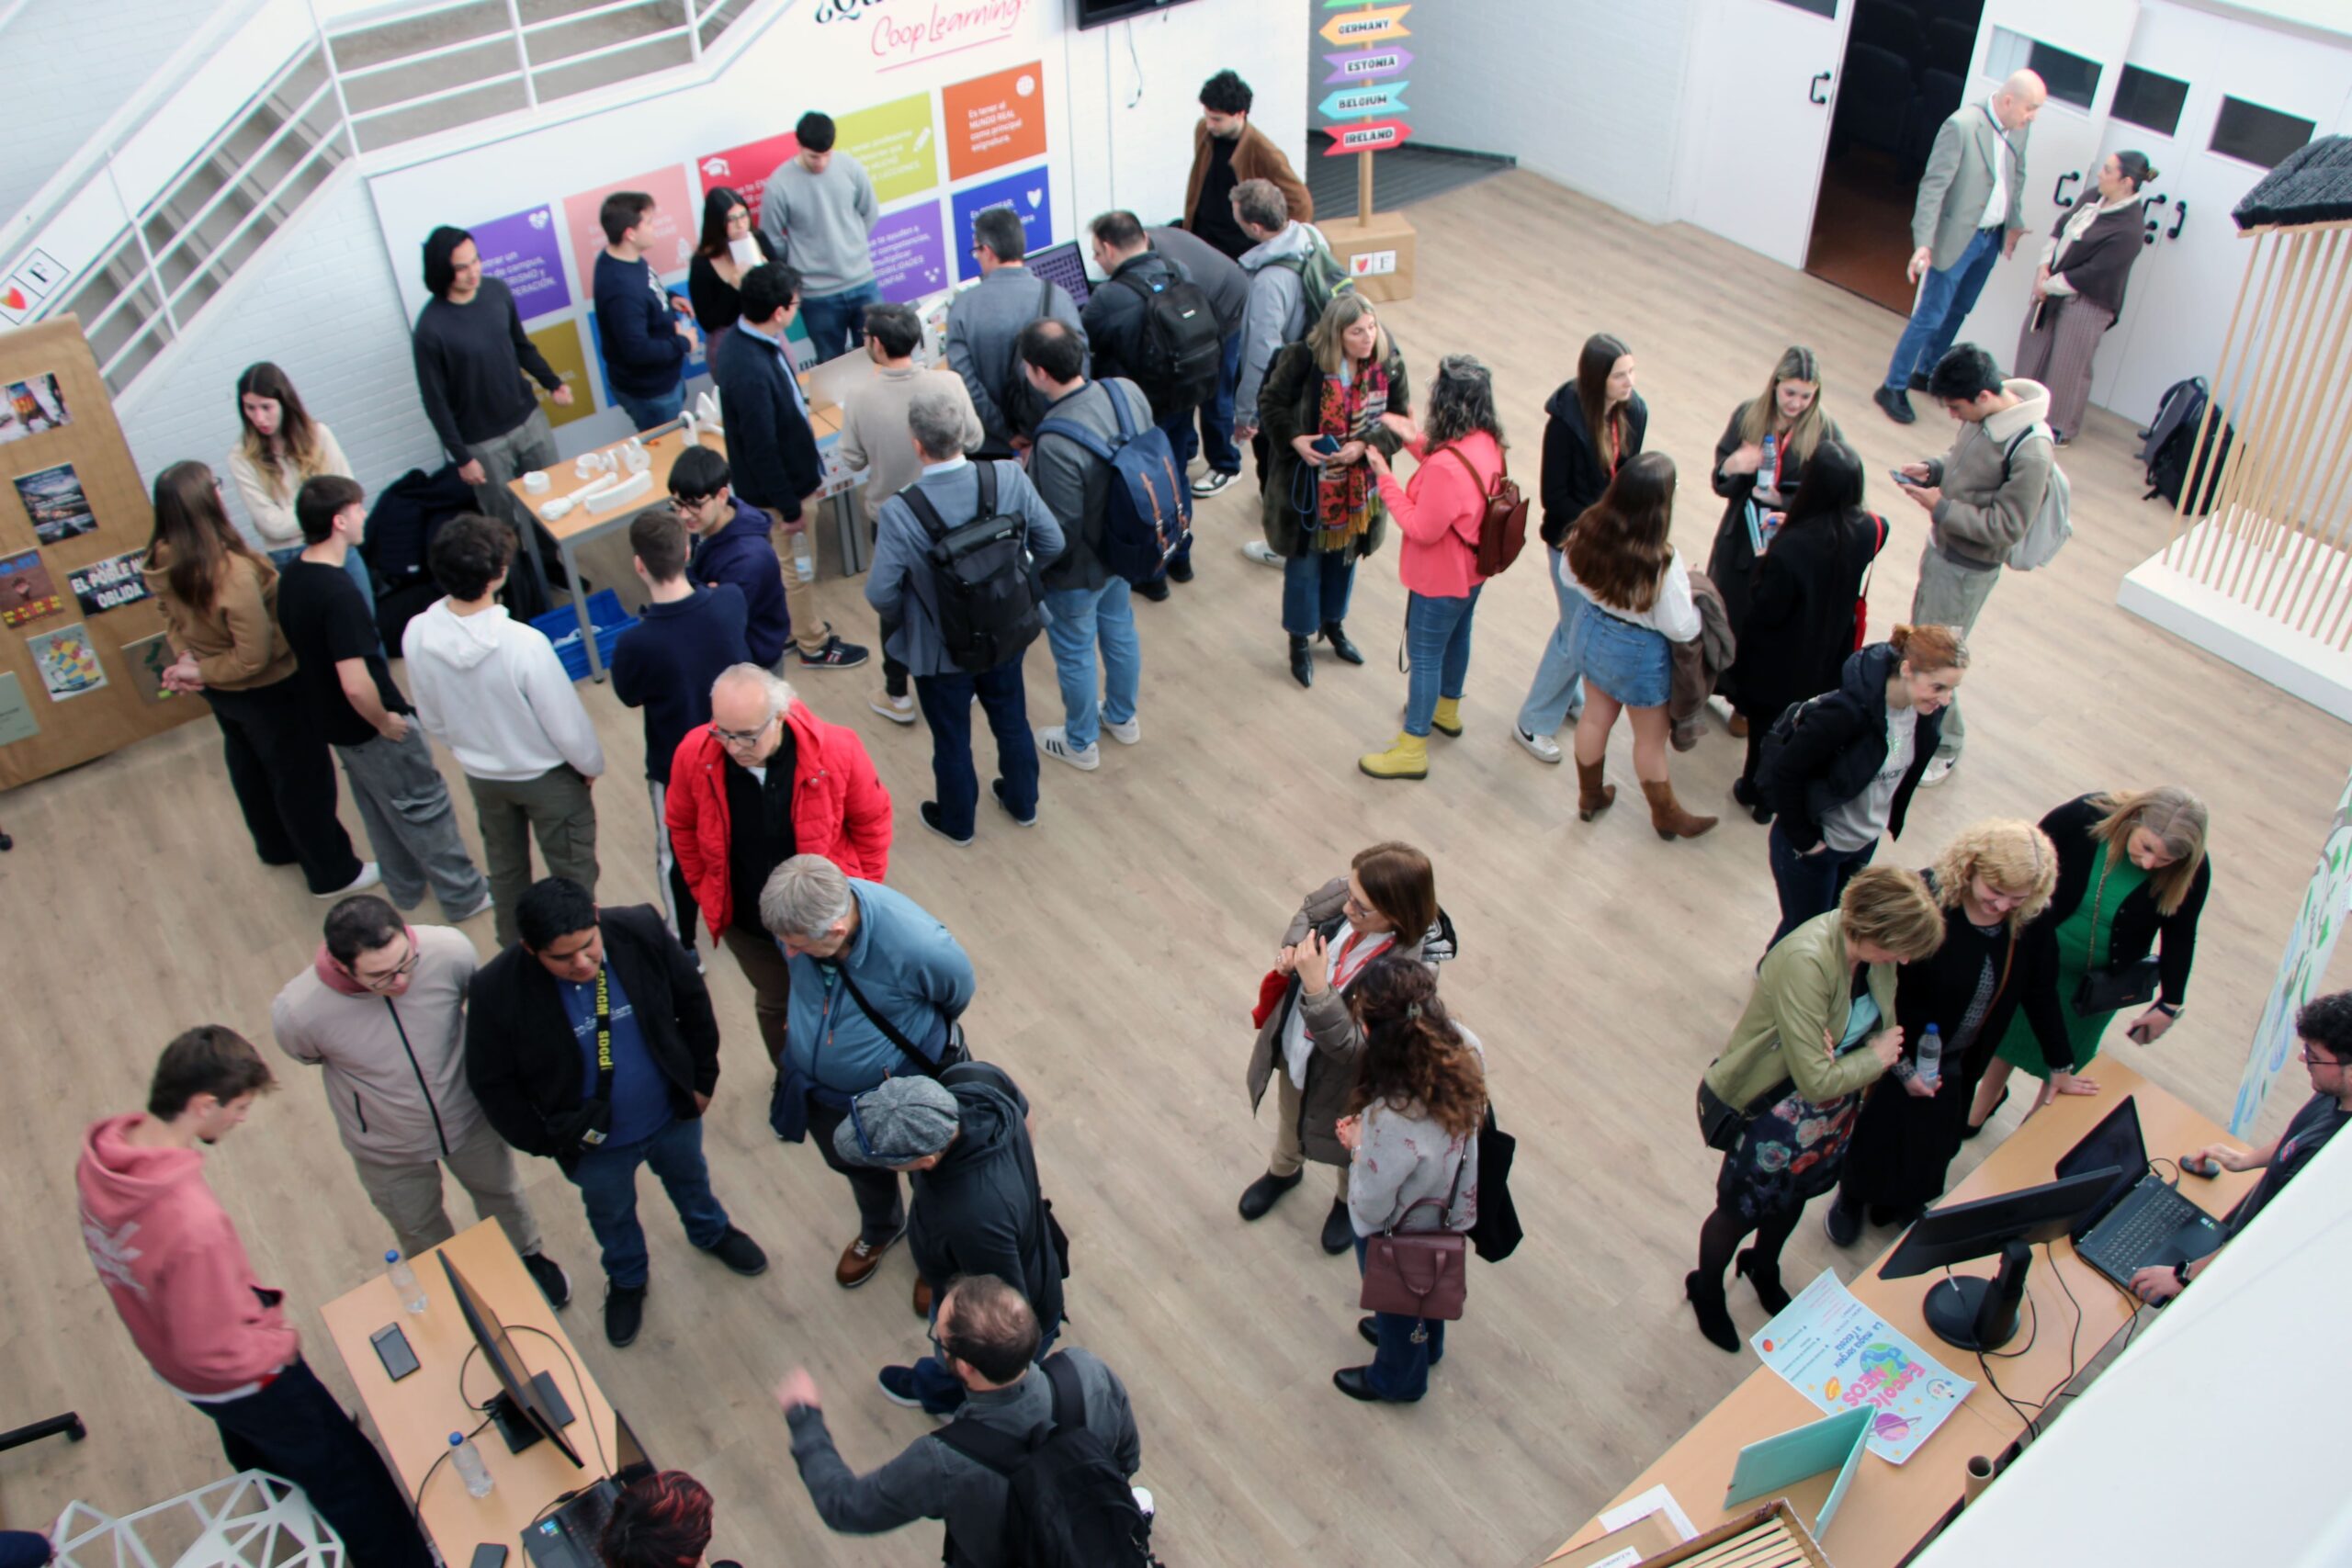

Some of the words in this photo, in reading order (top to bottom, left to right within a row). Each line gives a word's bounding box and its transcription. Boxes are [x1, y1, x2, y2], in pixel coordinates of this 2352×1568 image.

[1338, 19, 1389, 34] GERMANY
[1347, 56, 1396, 72] ESTONIA
[1339, 95, 1386, 109] BELGIUM
[969, 114, 997, 130] MUNDO
[996, 109, 1015, 121] REAL
[1345, 129, 1393, 144] IRELAND
[71, 577, 91, 595] EL
[88, 559, 132, 589] POBLE
[96, 581, 145, 609] OBLIDA
[1841, 1366, 1889, 1407] NEOS
